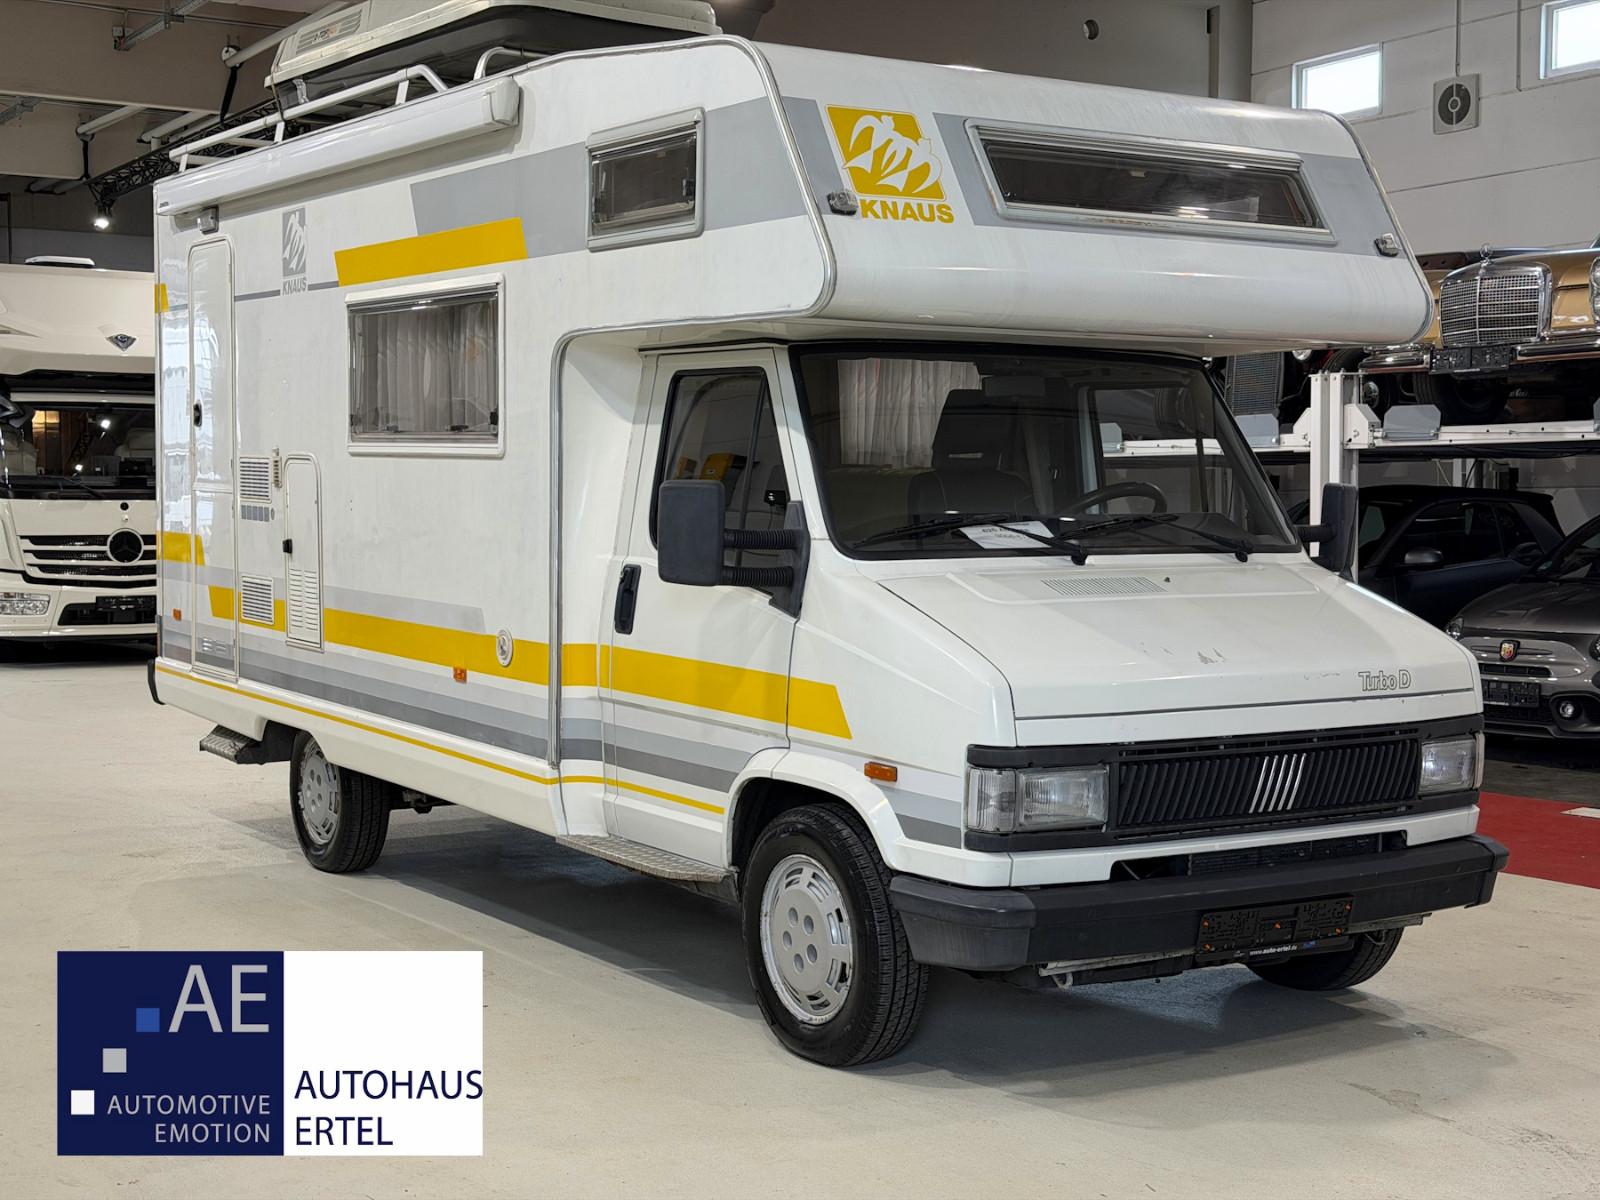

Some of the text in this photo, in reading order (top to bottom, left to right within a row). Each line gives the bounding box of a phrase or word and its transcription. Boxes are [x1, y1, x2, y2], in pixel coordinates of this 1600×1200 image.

[860, 199, 954, 224] KNAUS
[282, 277, 306, 295] KNAUS
[1358, 669, 1412, 691] Turbo D
